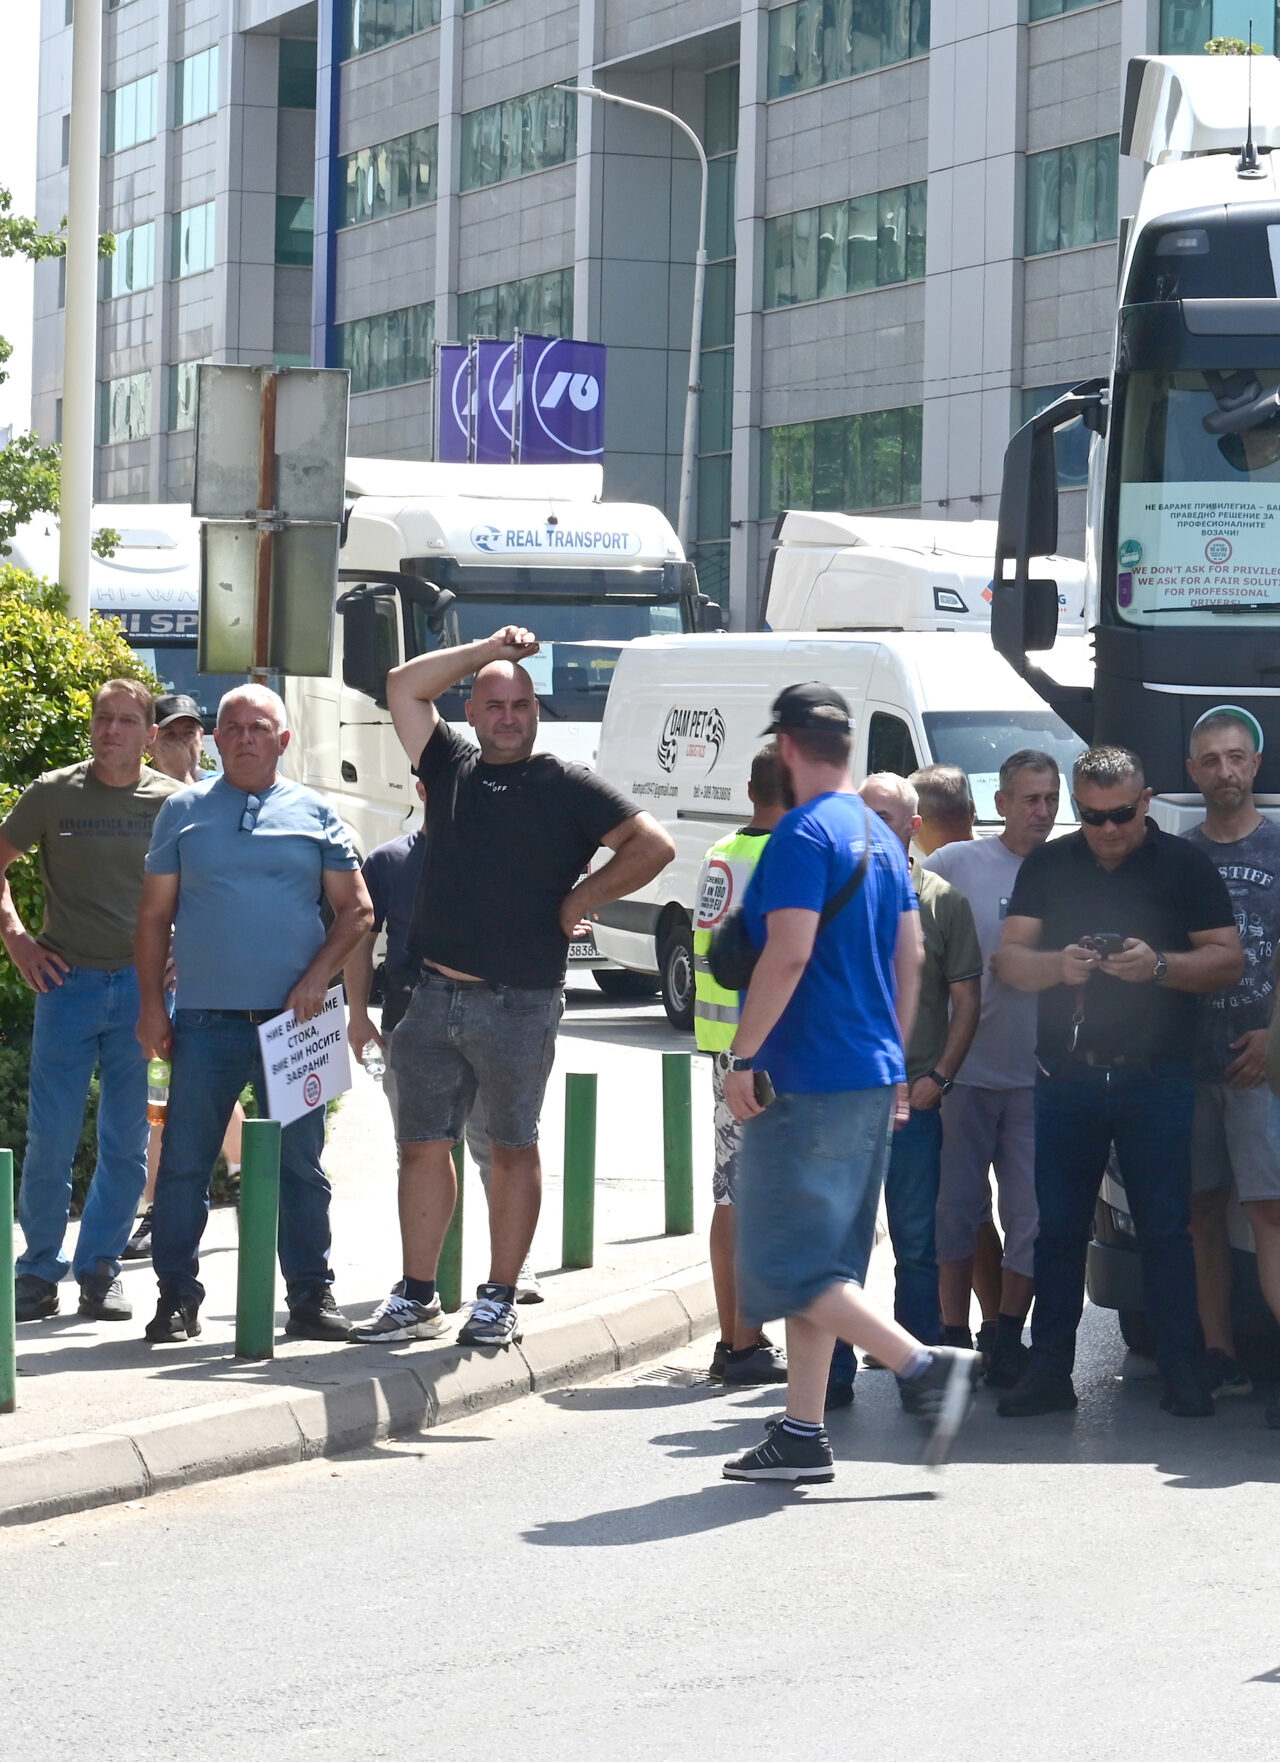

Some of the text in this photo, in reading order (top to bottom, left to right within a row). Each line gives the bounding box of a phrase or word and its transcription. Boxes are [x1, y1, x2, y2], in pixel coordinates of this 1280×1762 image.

[1145, 503, 1157, 511] НЕ
[1158, 503, 1192, 511] БАРАМЕ
[1194, 503, 1256, 511] ПРИВИЛЕГИЈА
[1170, 511, 1216, 520] ПРАВЕДНО
[1218, 512, 1261, 520] РЕШЕНИЕ
[1177, 520, 1265, 528] ПРОФЕСИОНАЛНИТЕ
[506, 529, 542, 547] REAL
[547, 529, 630, 550] TRANSPORT
[1131, 567, 1147, 575] WE
[1150, 566, 1182, 575] DON'T
[1185, 565, 1205, 574] ASK
[1208, 565, 1230, 574] FOR
[1138, 577, 1154, 585] WE
[1156, 577, 1177, 585] ASK
[1180, 577, 1200, 585] FOR
[1203, 577, 1211, 585] A
[1214, 577, 1240, 585] FAIR
[96, 587, 199, 602] HI-WA
[1164, 588, 1270, 597] FOR PROFESSIONAL
[1190, 599, 1240, 607] DRIVERS!
[670, 709, 708, 738] DAM PET
[1218, 866, 1274, 887] STIFF
[265, 1024, 284, 1042] НИЕ
[285, 1018, 298, 1032] ВИ
[287, 1025, 320, 1049] СТОКА,
[272, 1030, 341, 1076] ВИЕ НИ НОСИТЕ
[285, 1052, 329, 1085] ЗАБРАНИ!
